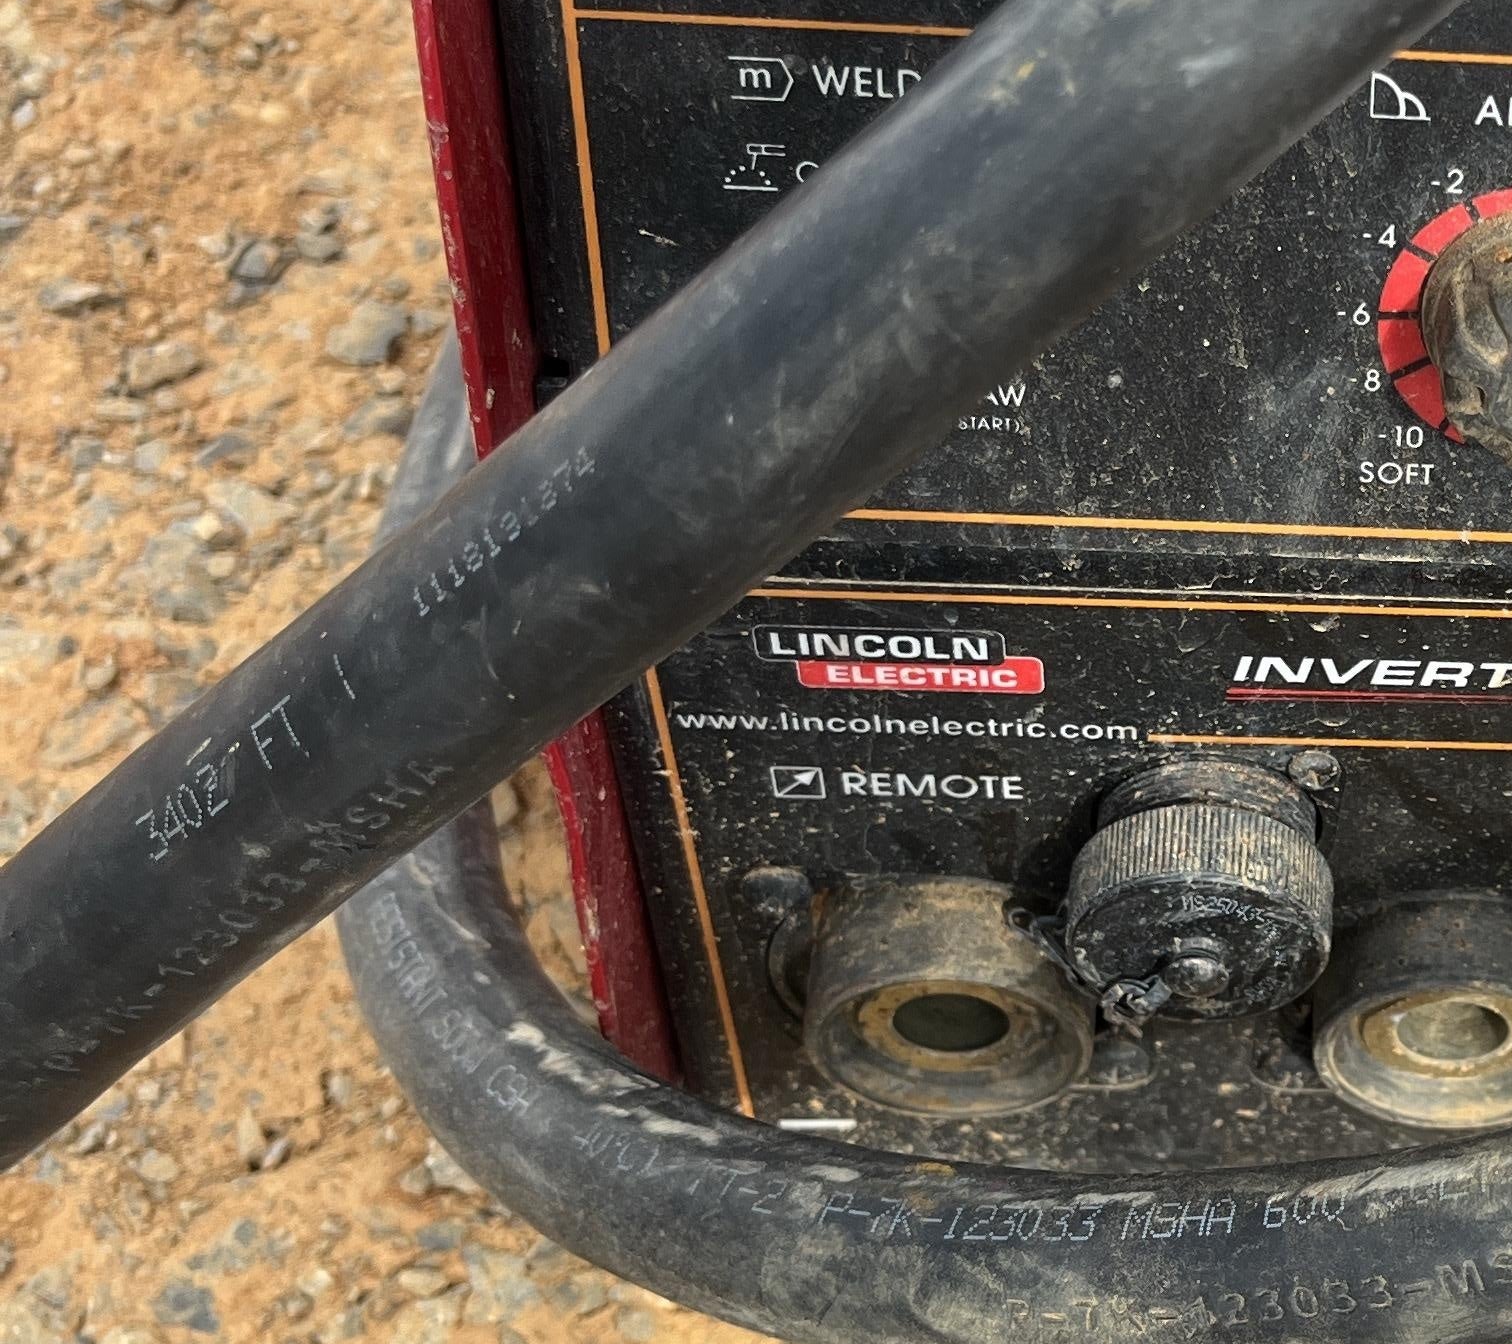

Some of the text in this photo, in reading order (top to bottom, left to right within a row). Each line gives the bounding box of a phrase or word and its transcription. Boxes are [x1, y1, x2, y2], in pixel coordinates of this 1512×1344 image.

[1431, 168, 1465, 195] -2
[1362, 224, 1397, 249] -4
[1336, 301, 1372, 327] -6
[1349, 369, 1382, 393] -8
[1378, 425, 1424, 449] -10
[1358, 460, 1435, 486] SOFT
[768, 631, 989, 662] LINCOLN
[826, 665, 1019, 689] ELECTRIC
[250, 694, 311, 771] FT
[676, 710, 1139, 741] www.lincolnelectric.com
[841, 773, 1024, 800] REMOTE
